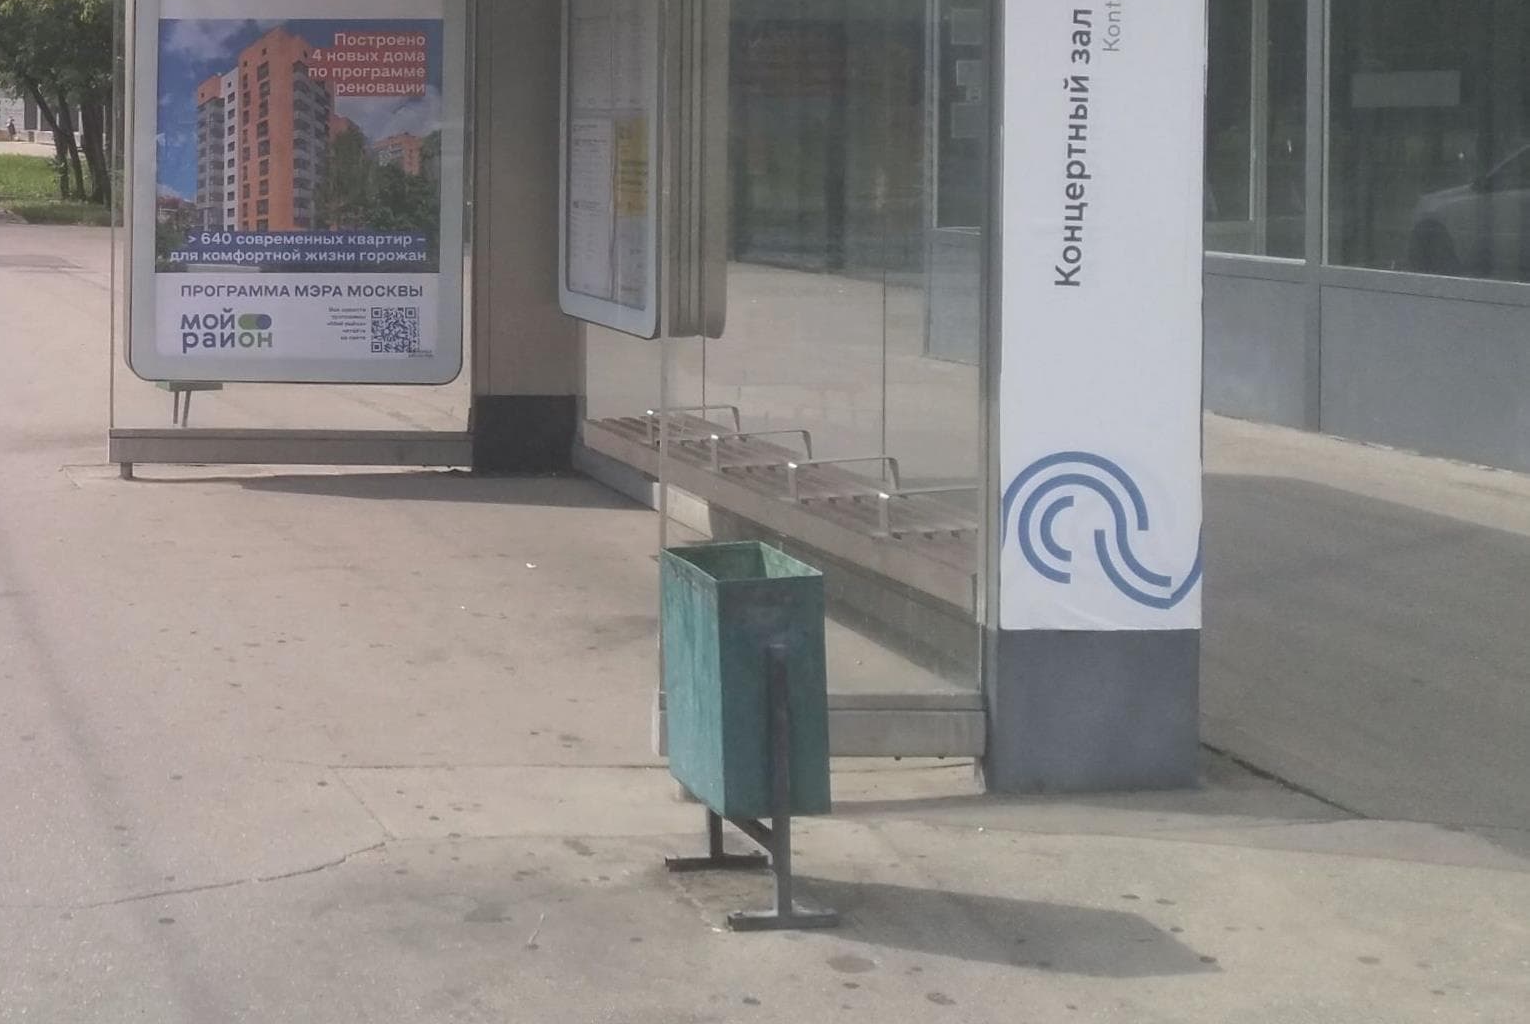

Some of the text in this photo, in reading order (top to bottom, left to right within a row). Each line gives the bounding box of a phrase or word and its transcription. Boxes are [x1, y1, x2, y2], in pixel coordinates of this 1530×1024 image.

[334, 33, 426, 48] Построено
[1070, 8, 1093, 65] зал
[312, 49, 426, 63] 4 новых дома
[308, 67, 426, 80] по программе
[336, 83, 426, 95] реновации
[1054, 75, 1092, 287] Концертный
[201, 233, 231, 245] 640
[236, 235, 343, 247] современных
[348, 235, 412, 248] квартир
[170, 249, 426, 264] для комфортной жизни горожан
[181, 285, 423, 297] ПРОГРАММА МЭРА МОСКВЫ
[180, 307, 236, 330] мой
